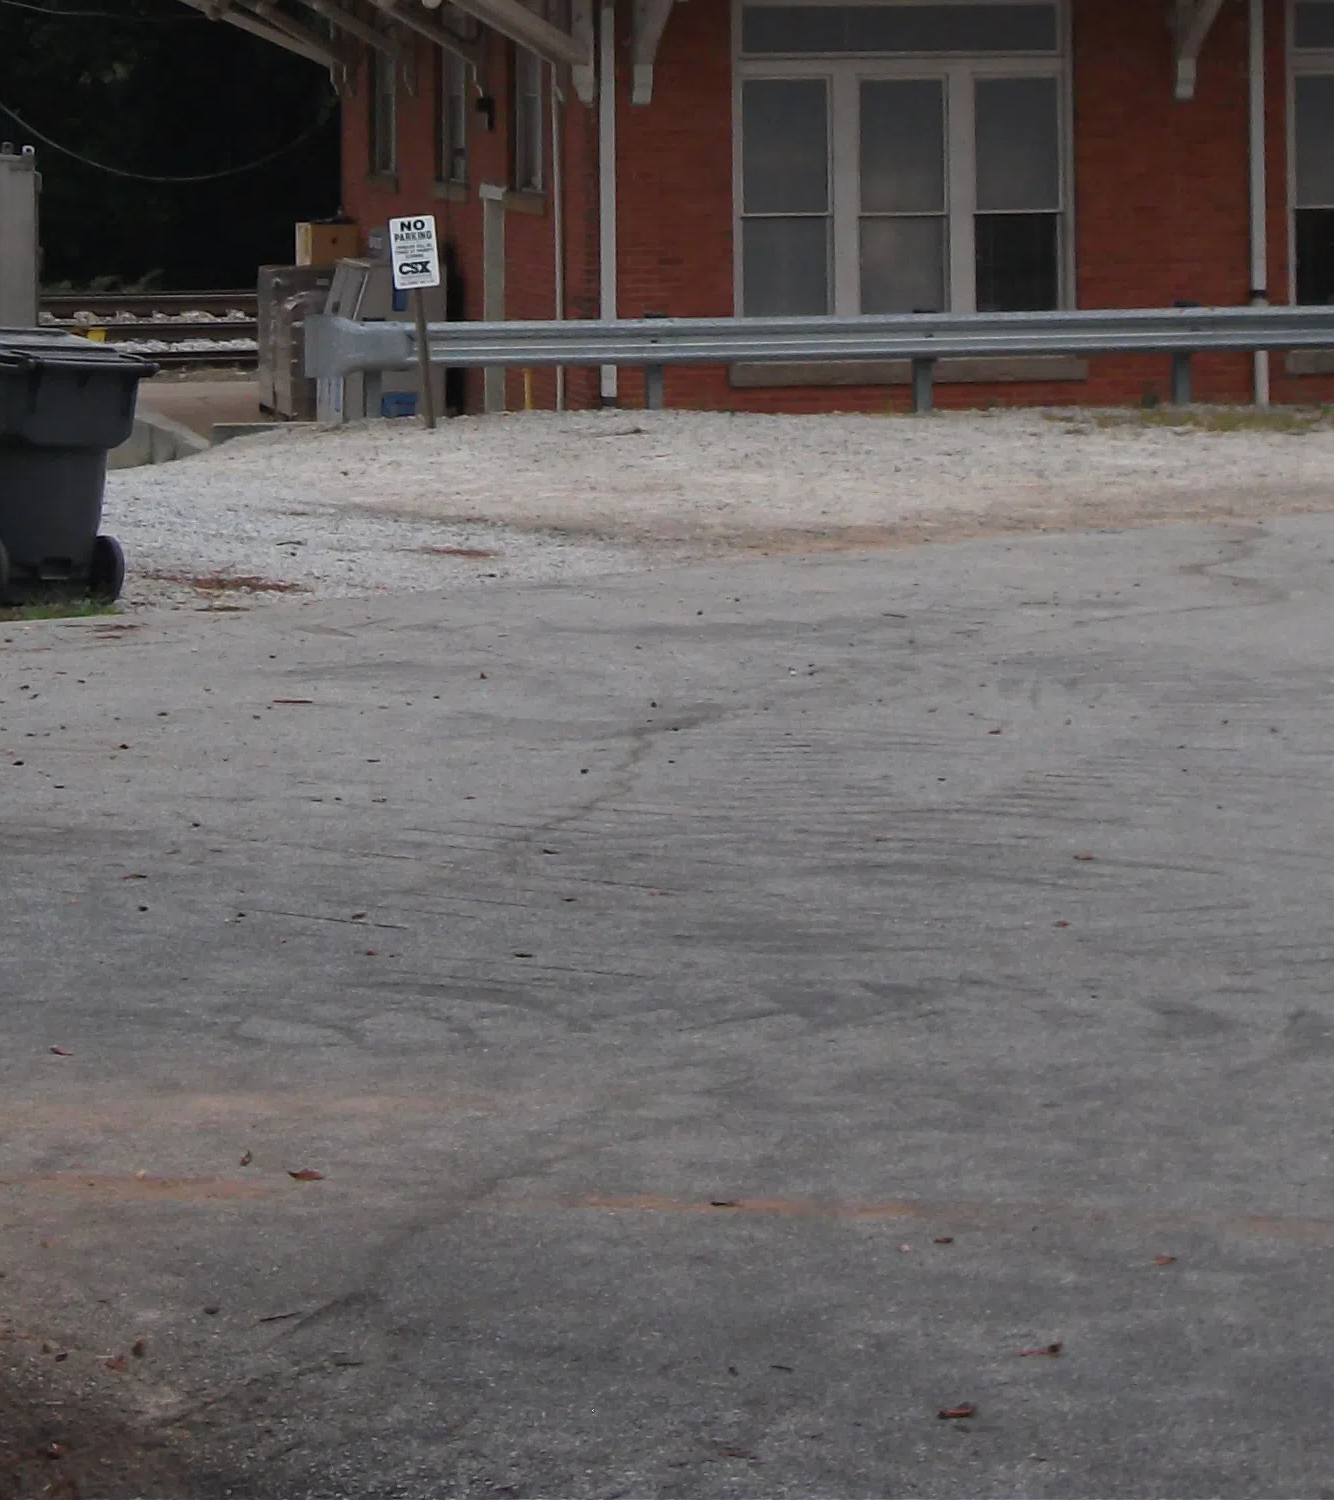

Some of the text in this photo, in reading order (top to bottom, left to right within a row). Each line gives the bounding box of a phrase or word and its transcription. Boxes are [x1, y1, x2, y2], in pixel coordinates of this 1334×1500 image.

[399, 219, 425, 231] NO
[394, 230, 433, 242] PARKING
[399, 261, 431, 275] CSX
